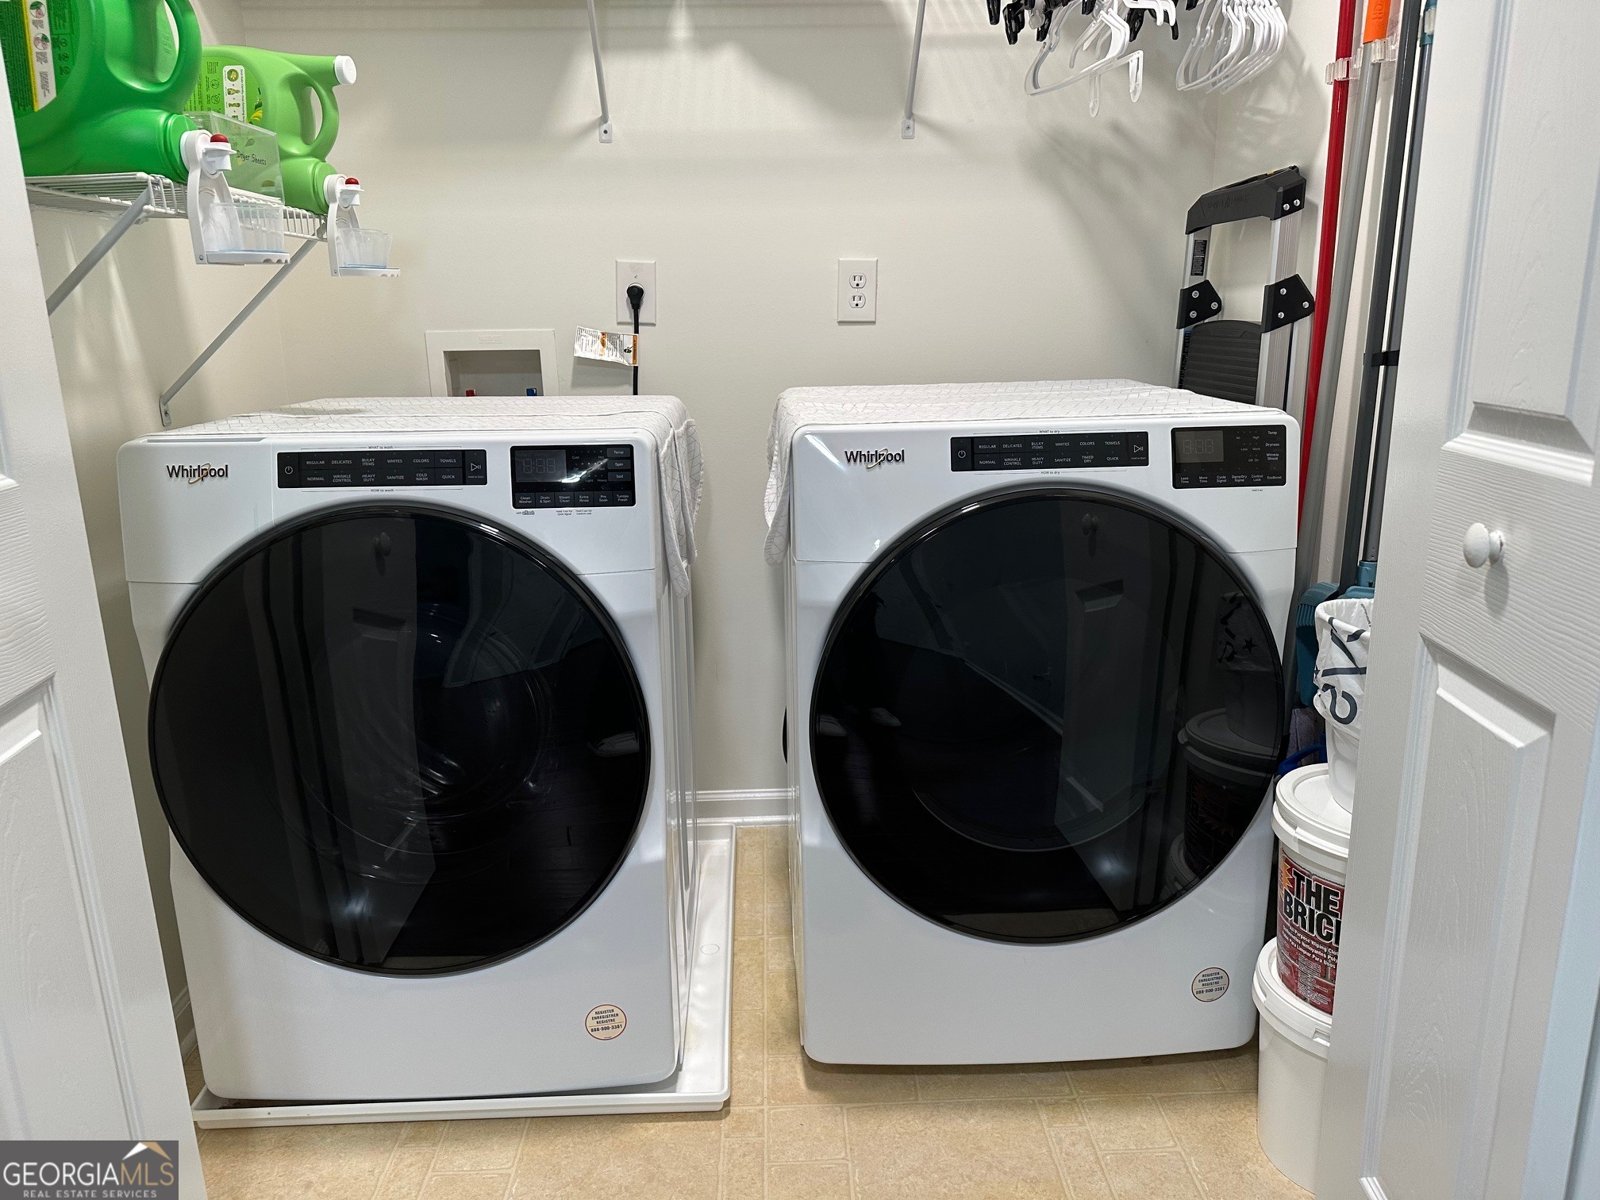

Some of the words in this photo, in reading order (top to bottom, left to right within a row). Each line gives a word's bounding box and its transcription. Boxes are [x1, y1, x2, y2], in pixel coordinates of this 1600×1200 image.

[844, 448, 905, 469] Whirlpool
[166, 463, 229, 484] Whirlpool
[1291, 868, 1341, 919] THE
